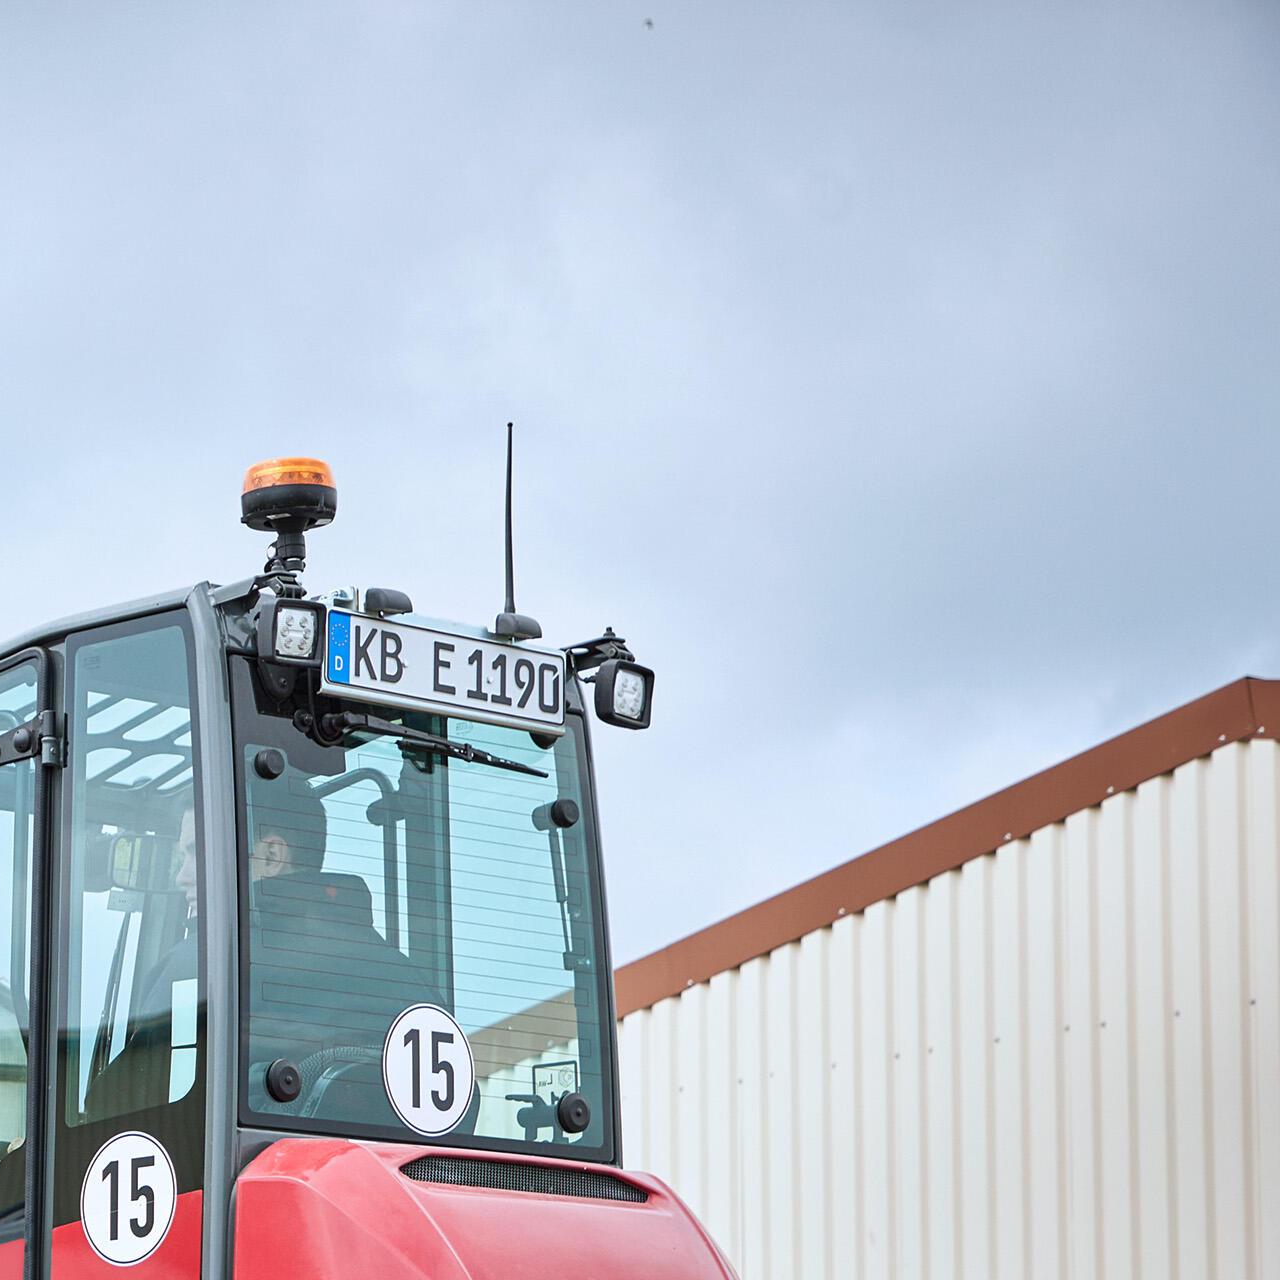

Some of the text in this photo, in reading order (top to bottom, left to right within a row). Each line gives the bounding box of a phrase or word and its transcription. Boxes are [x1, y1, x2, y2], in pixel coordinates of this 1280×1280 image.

[354, 625, 404, 684] KB
[403, 1028, 455, 1112] 15
[101, 1155, 156, 1242] 15
